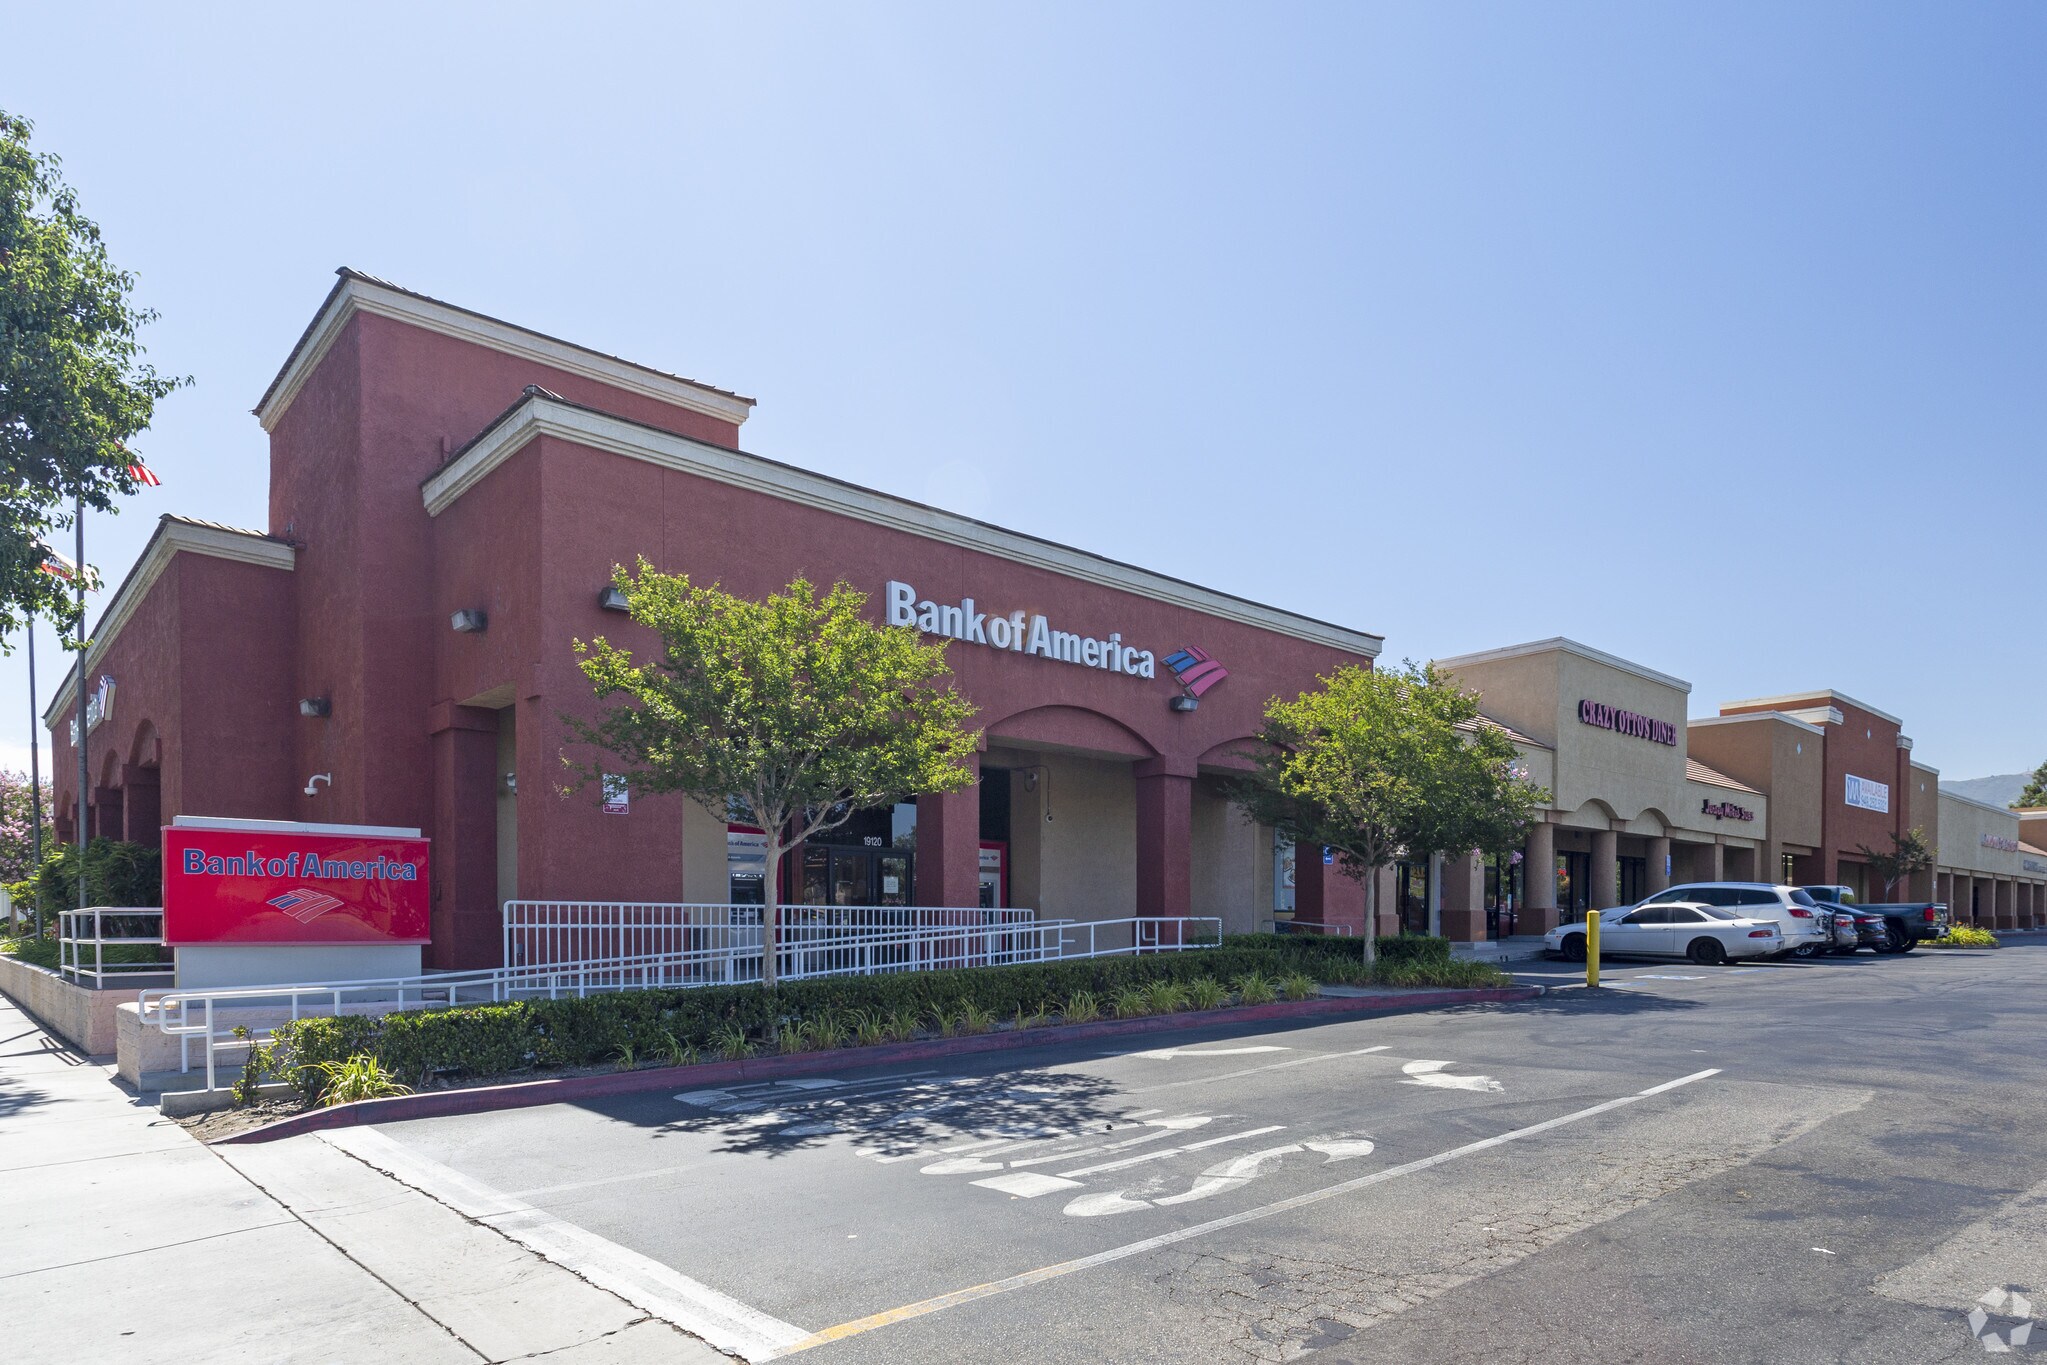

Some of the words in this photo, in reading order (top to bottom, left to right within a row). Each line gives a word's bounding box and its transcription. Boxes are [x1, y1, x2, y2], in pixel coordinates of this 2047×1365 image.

[886, 580, 987, 646] Bank
[987, 610, 1025, 653] of
[1025, 614, 1156, 679] America
[1579, 699, 1616, 730] CRAZY
[1651, 719, 1677, 746] DINER
[1861, 780, 1887, 799] AVAILABLE
[863, 836, 882, 847] 19120
[184, 848, 266, 877] Bank
[268, 851, 299, 878] of
[302, 853, 417, 881] America
